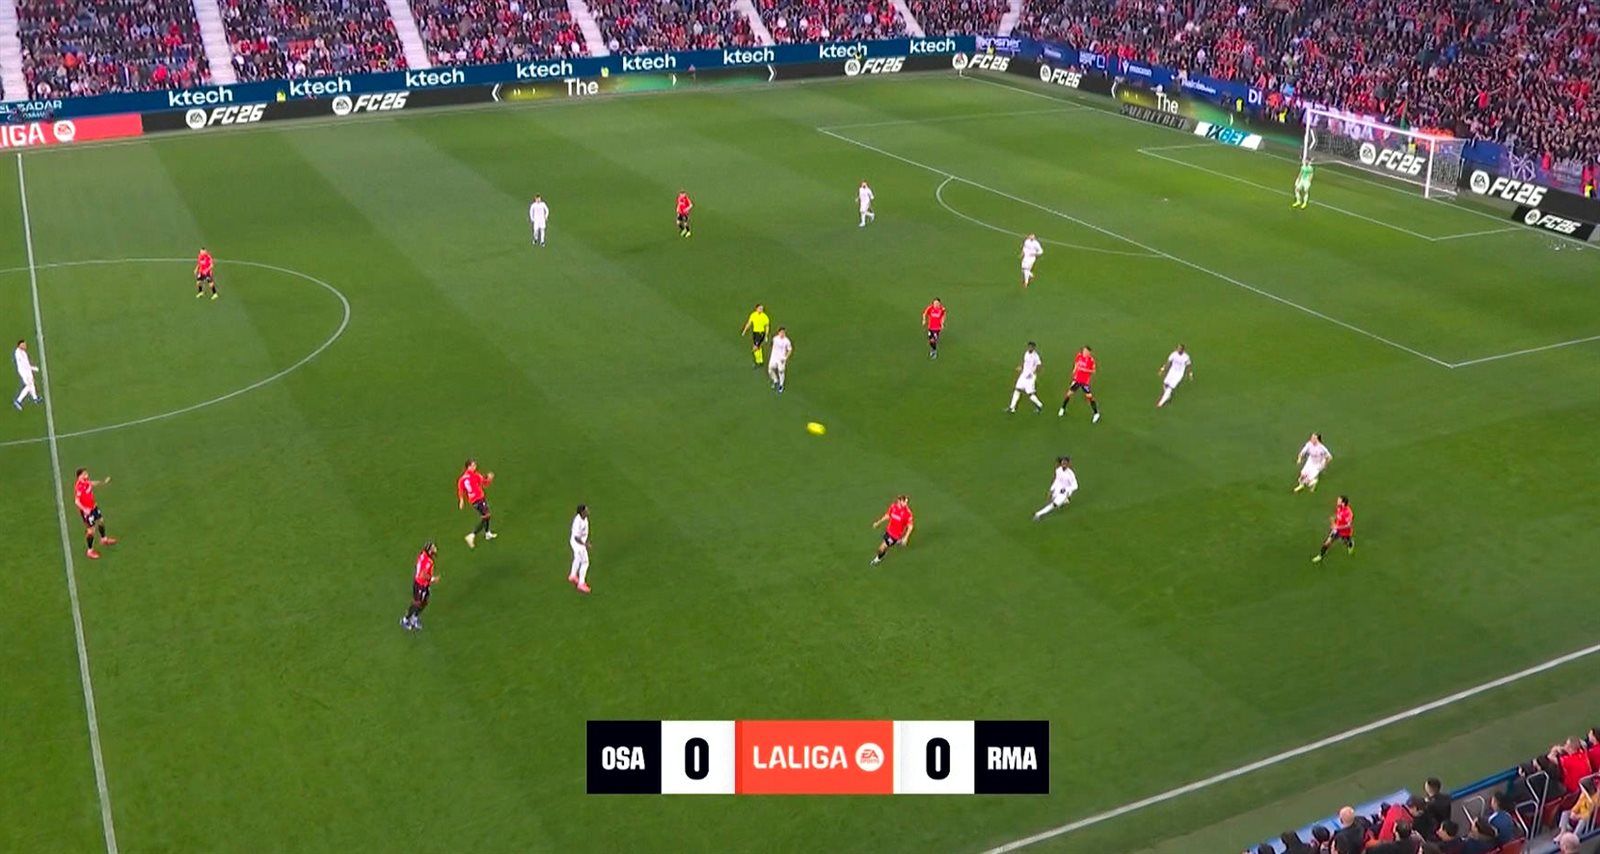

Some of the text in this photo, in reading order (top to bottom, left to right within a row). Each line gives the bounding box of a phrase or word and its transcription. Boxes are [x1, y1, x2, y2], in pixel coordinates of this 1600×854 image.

[723, 47, 775, 64] ktech
[820, 42, 868, 59] ktech
[909, 38, 956, 54] ktech
[516, 60, 573, 78] ktech
[622, 53, 677, 71] ktech
[860, 56, 906, 74] FC26
[967, 54, 1010, 72] FC26
[289, 76, 351, 96] ktech
[405, 68, 465, 87] ktech
[564, 78, 599, 96] The
[1050, 68, 1082, 89] FC26
[168, 86, 233, 107] ktech
[352, 91, 411, 113] FC26
[1155, 91, 1179, 114] The
[207, 103, 267, 126] FC26
[0, 121, 46, 148] IGA
[1375, 148, 1426, 176] FC26
[1487, 176, 1549, 208] FC26
[1537, 214, 1582, 234] FC26
